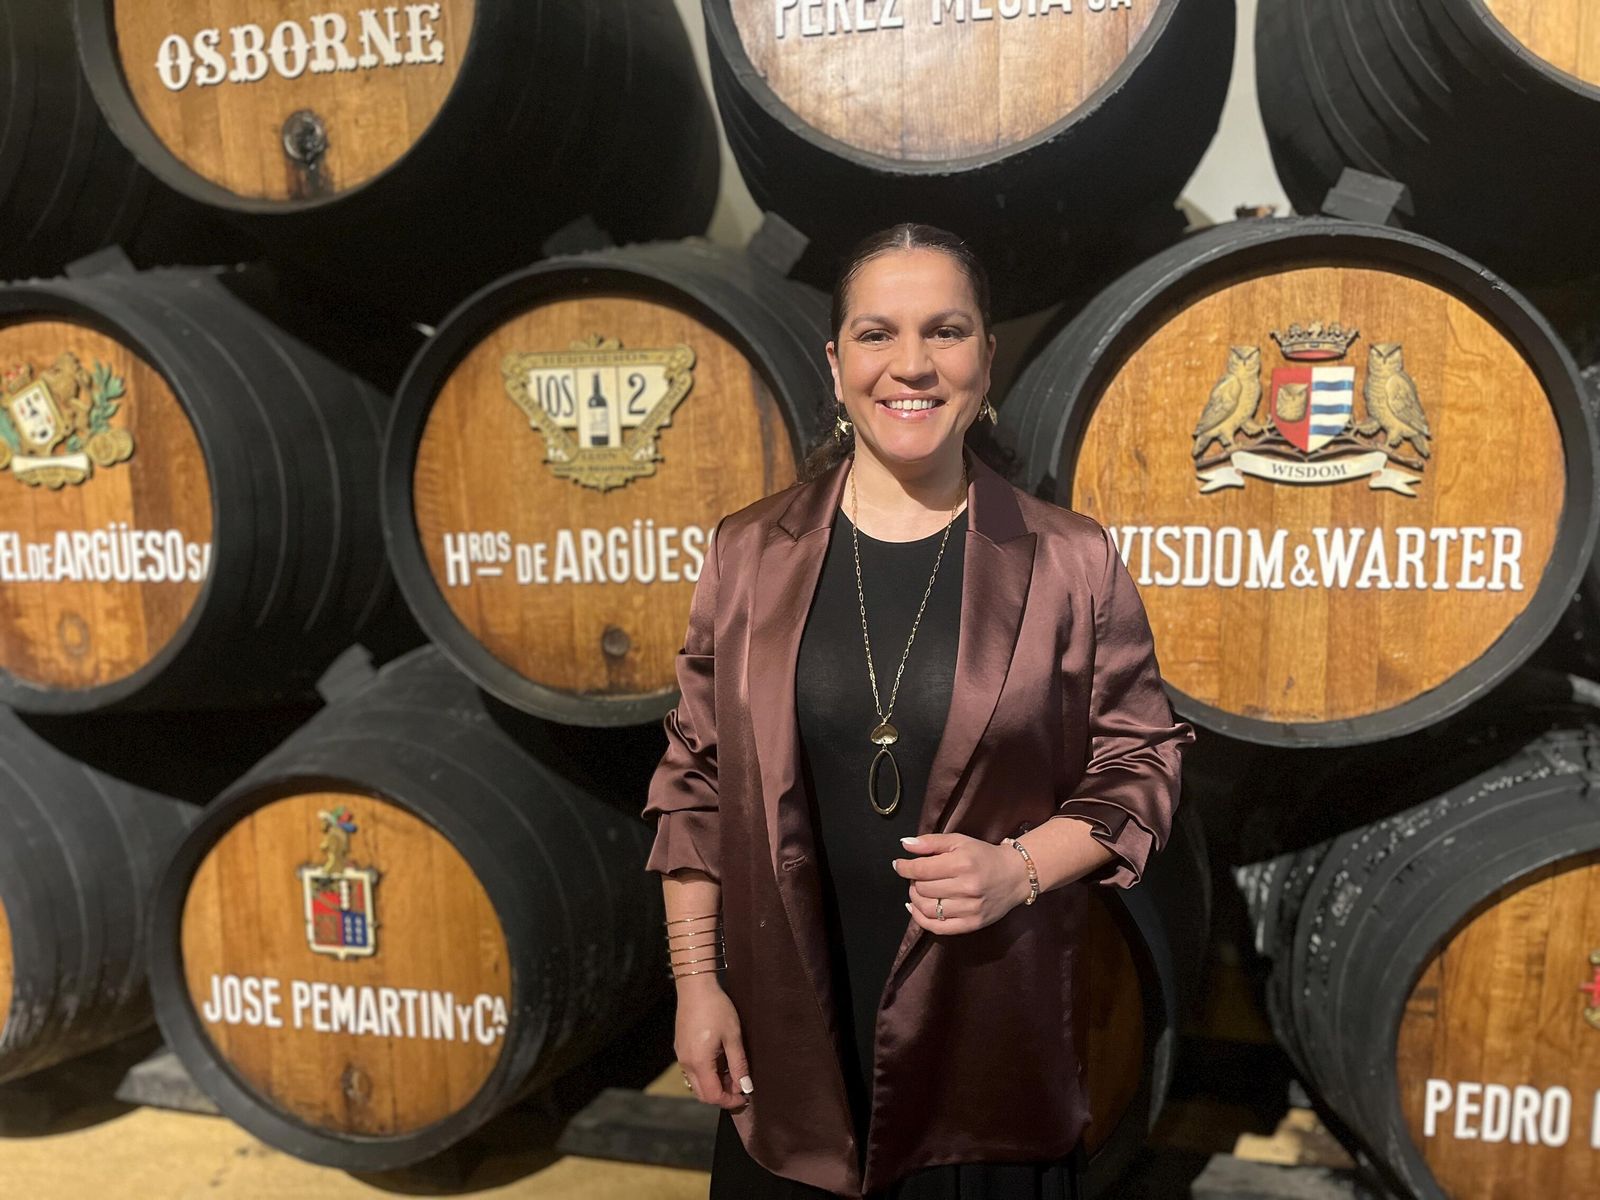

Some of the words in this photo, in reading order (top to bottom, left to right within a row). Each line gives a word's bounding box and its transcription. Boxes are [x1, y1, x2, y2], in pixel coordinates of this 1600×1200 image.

[155, 2, 445, 91] OSBORNE
[627, 372, 647, 415] 2
[1272, 463, 1348, 478] WISDOM
[53, 521, 187, 582] ARGÜESO
[515, 543, 549, 584] DE
[553, 519, 714, 584] ARGÜES
[202, 974, 283, 1028] JOSE
[1424, 1078, 1572, 1147] PEDRO
